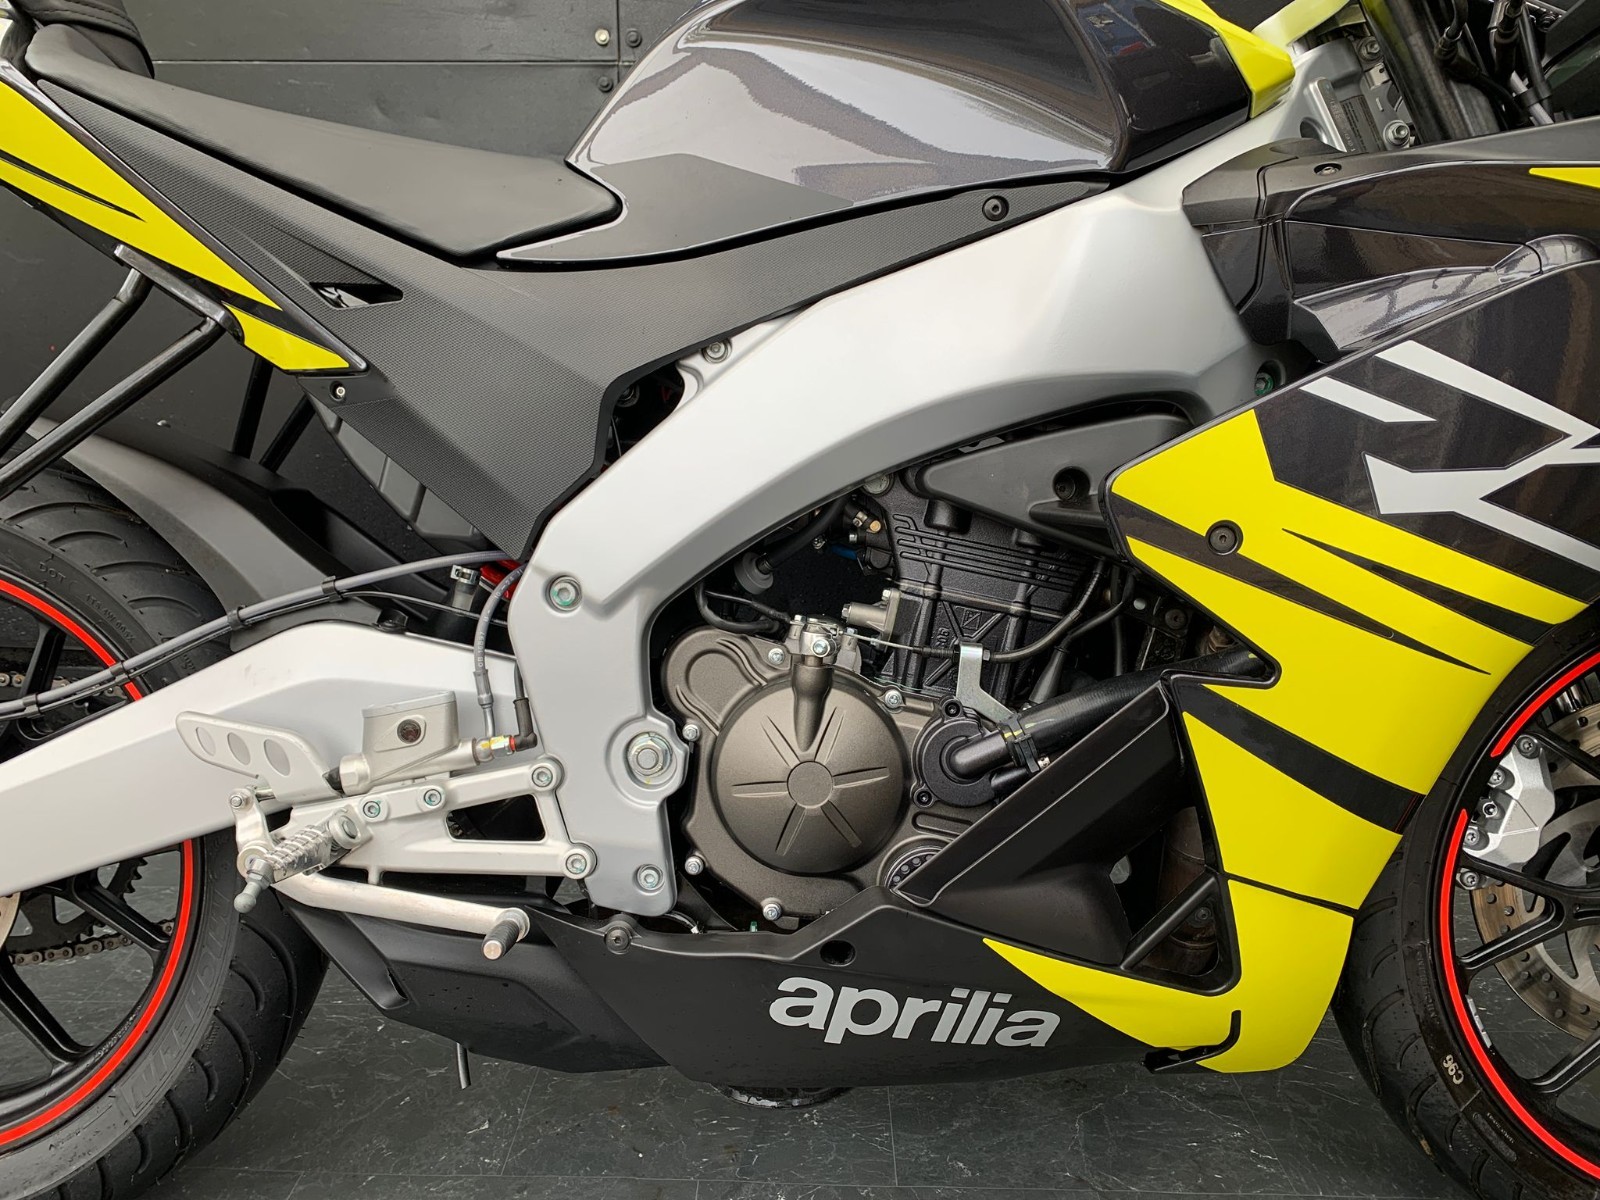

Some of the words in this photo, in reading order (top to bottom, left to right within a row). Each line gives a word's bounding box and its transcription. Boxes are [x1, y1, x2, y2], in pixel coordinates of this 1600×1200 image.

[39, 562, 66, 583] DOT
[768, 976, 1061, 1047] aprilia
[1442, 1054, 1465, 1085] C96
